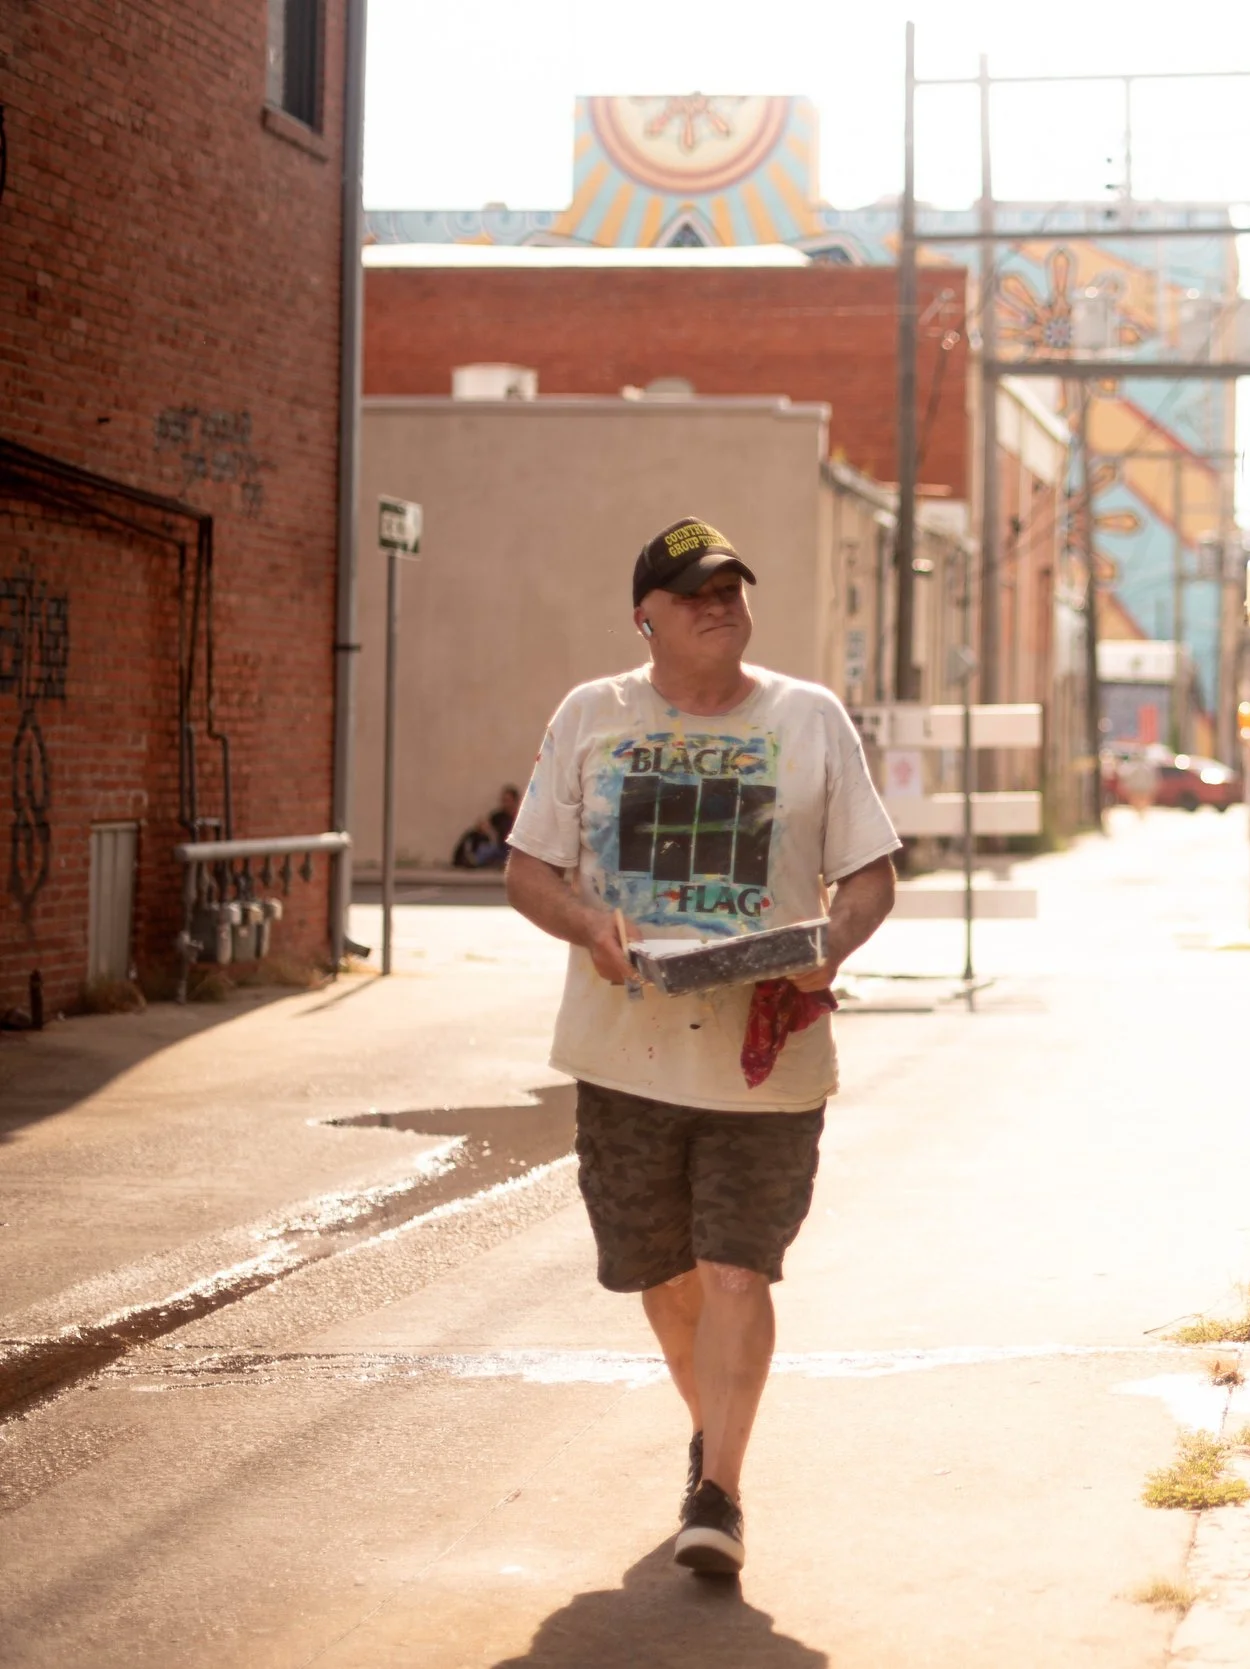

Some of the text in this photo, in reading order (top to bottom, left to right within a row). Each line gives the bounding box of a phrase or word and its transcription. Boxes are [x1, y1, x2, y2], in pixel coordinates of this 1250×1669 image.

[668, 536, 701, 558] GROUP
[630, 746, 743, 777] BLACK
[677, 884, 762, 918] FLAG
